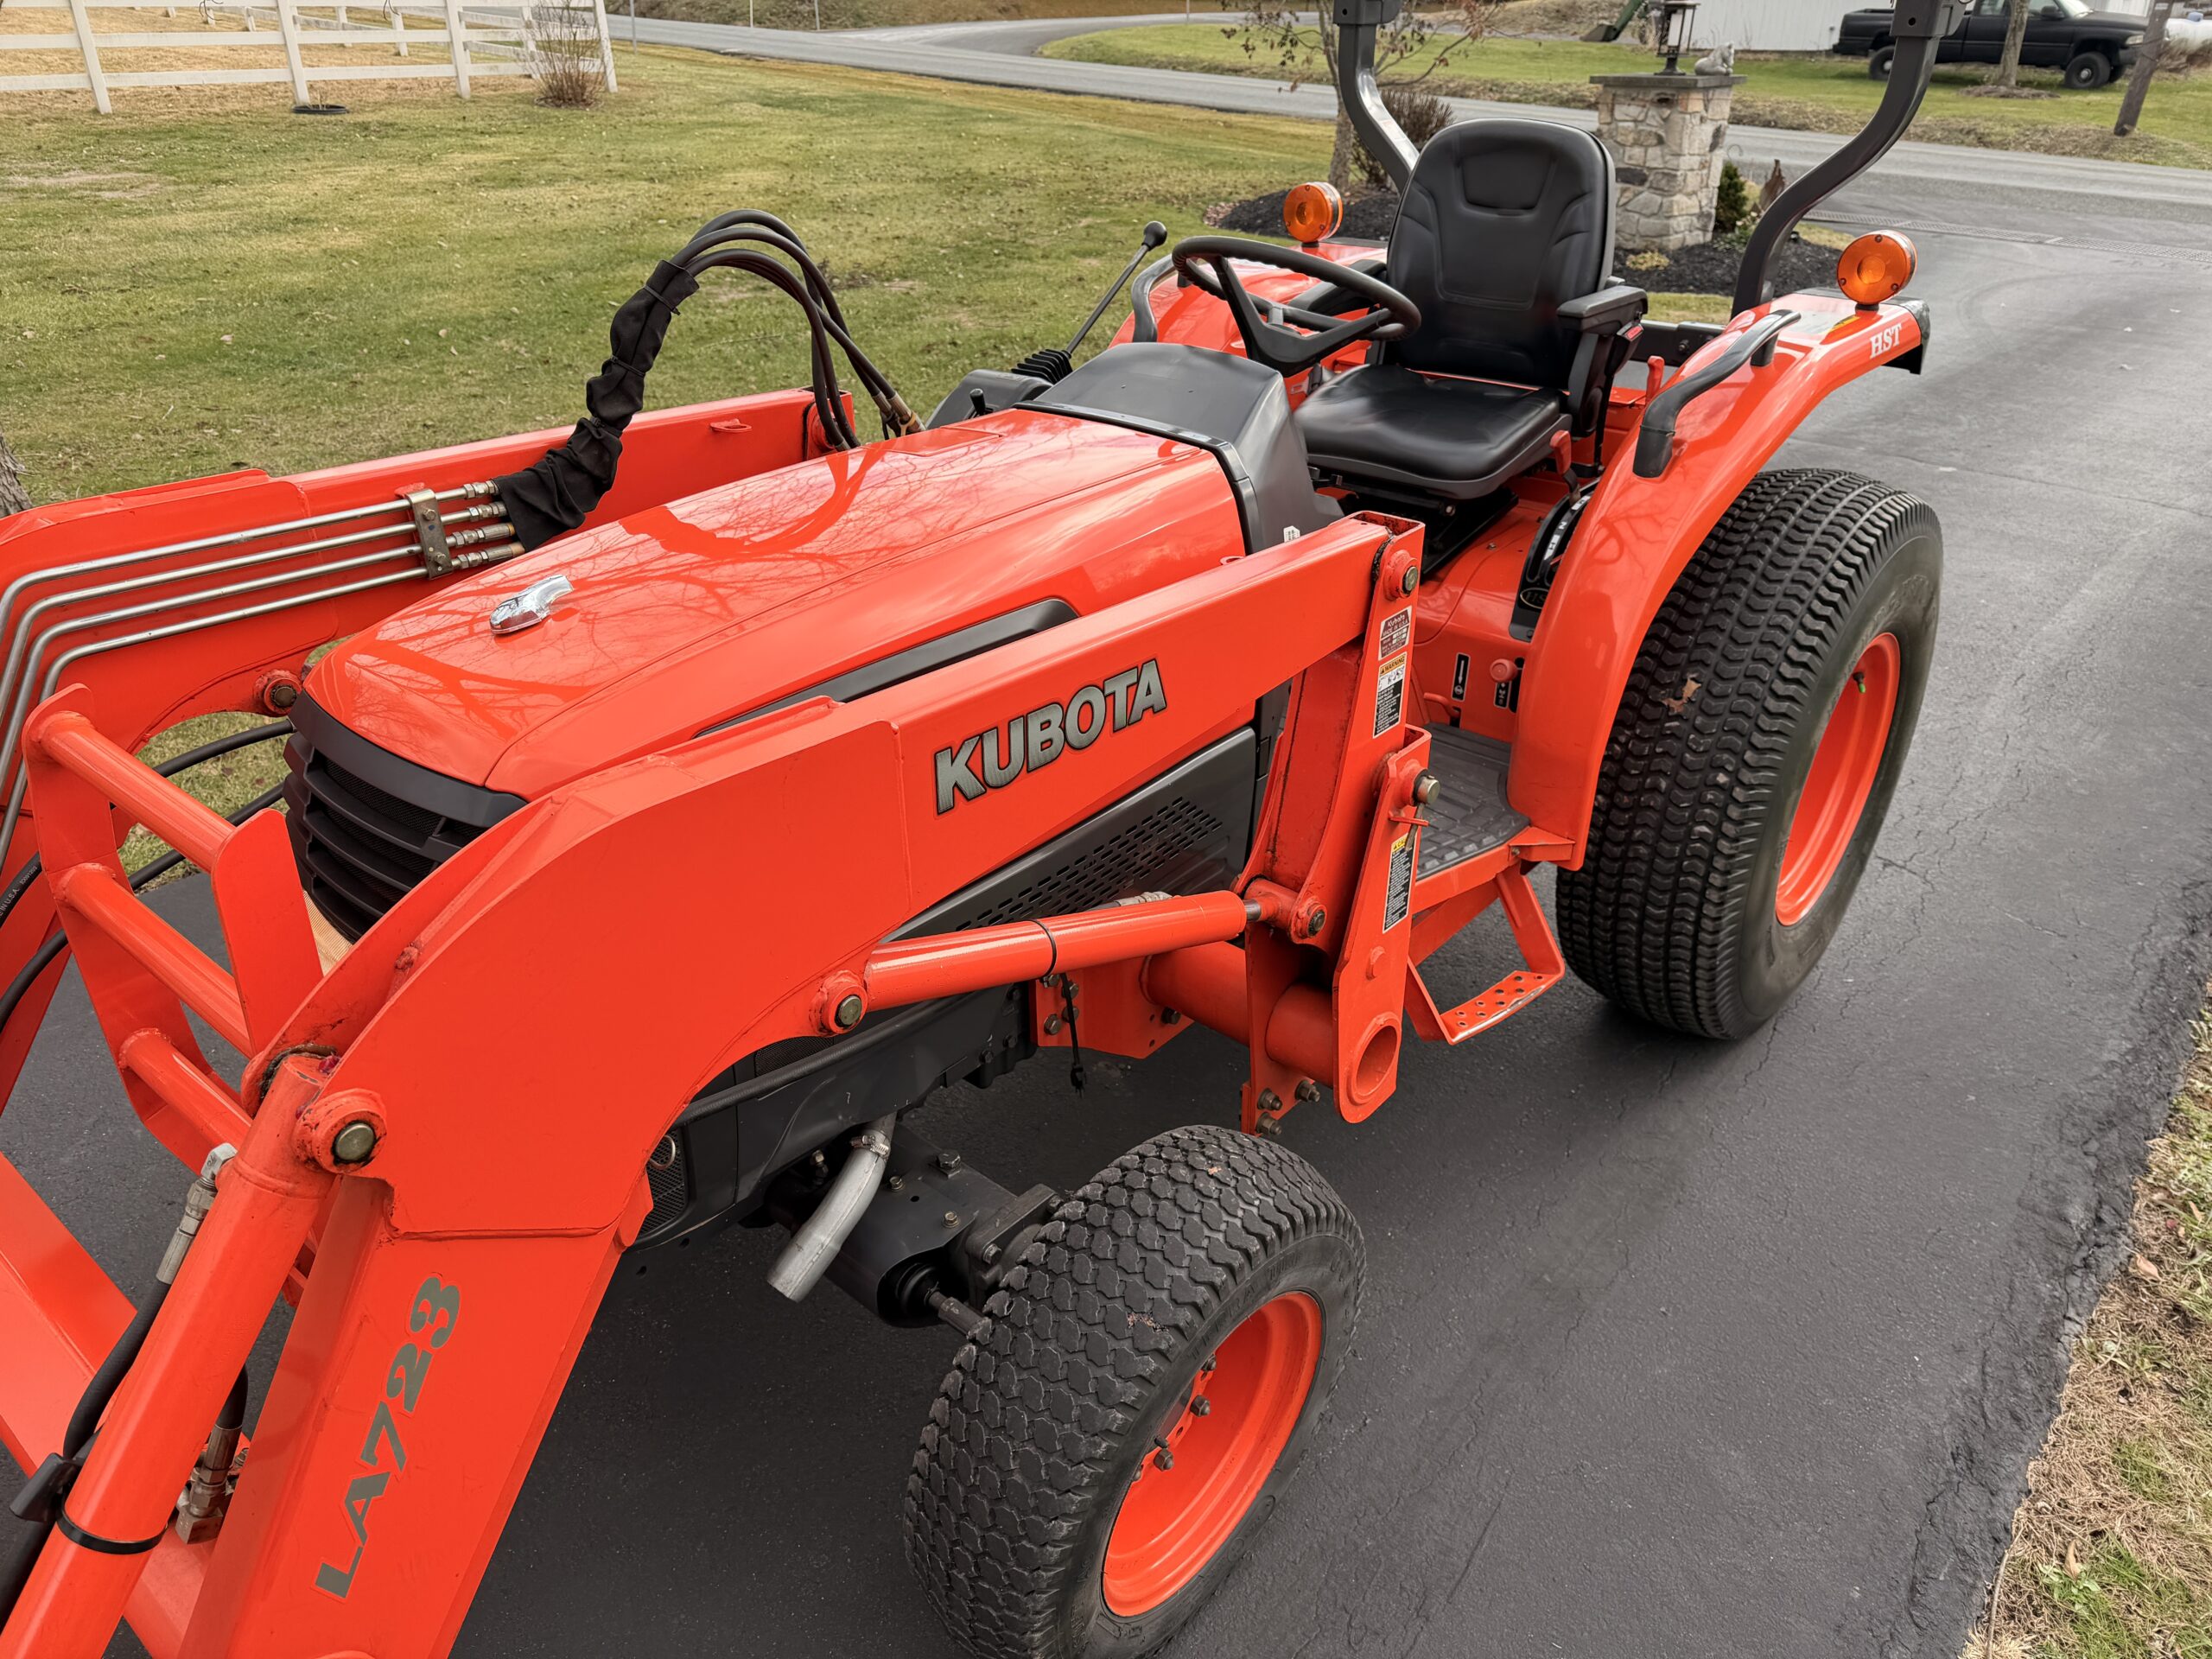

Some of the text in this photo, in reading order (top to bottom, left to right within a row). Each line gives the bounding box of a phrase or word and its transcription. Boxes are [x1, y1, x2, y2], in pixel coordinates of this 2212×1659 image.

[1869, 323, 1902, 359] HST
[1384, 656, 1405, 671] WARNING
[934, 658, 1166, 815] KUBOTA
[314, 1275, 461, 1599] LA723
